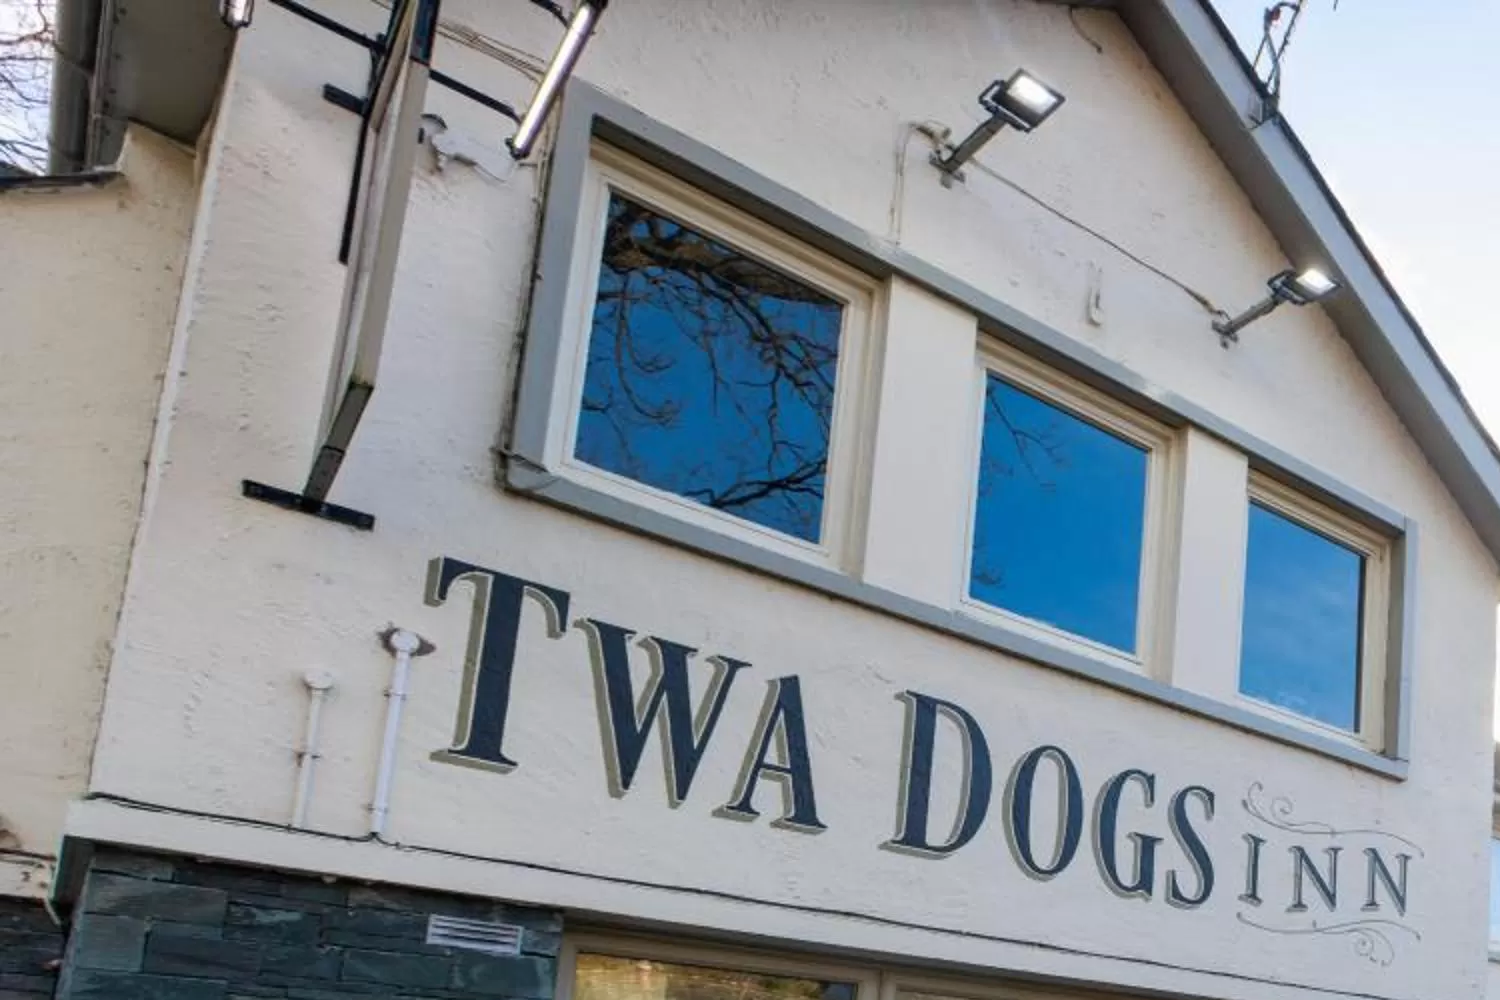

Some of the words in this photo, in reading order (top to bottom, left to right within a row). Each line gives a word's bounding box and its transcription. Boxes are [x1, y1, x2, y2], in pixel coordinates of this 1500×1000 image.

[424, 556, 827, 834] TWA
[877, 690, 1216, 911] DOGS
[1238, 832, 1412, 918] INN
